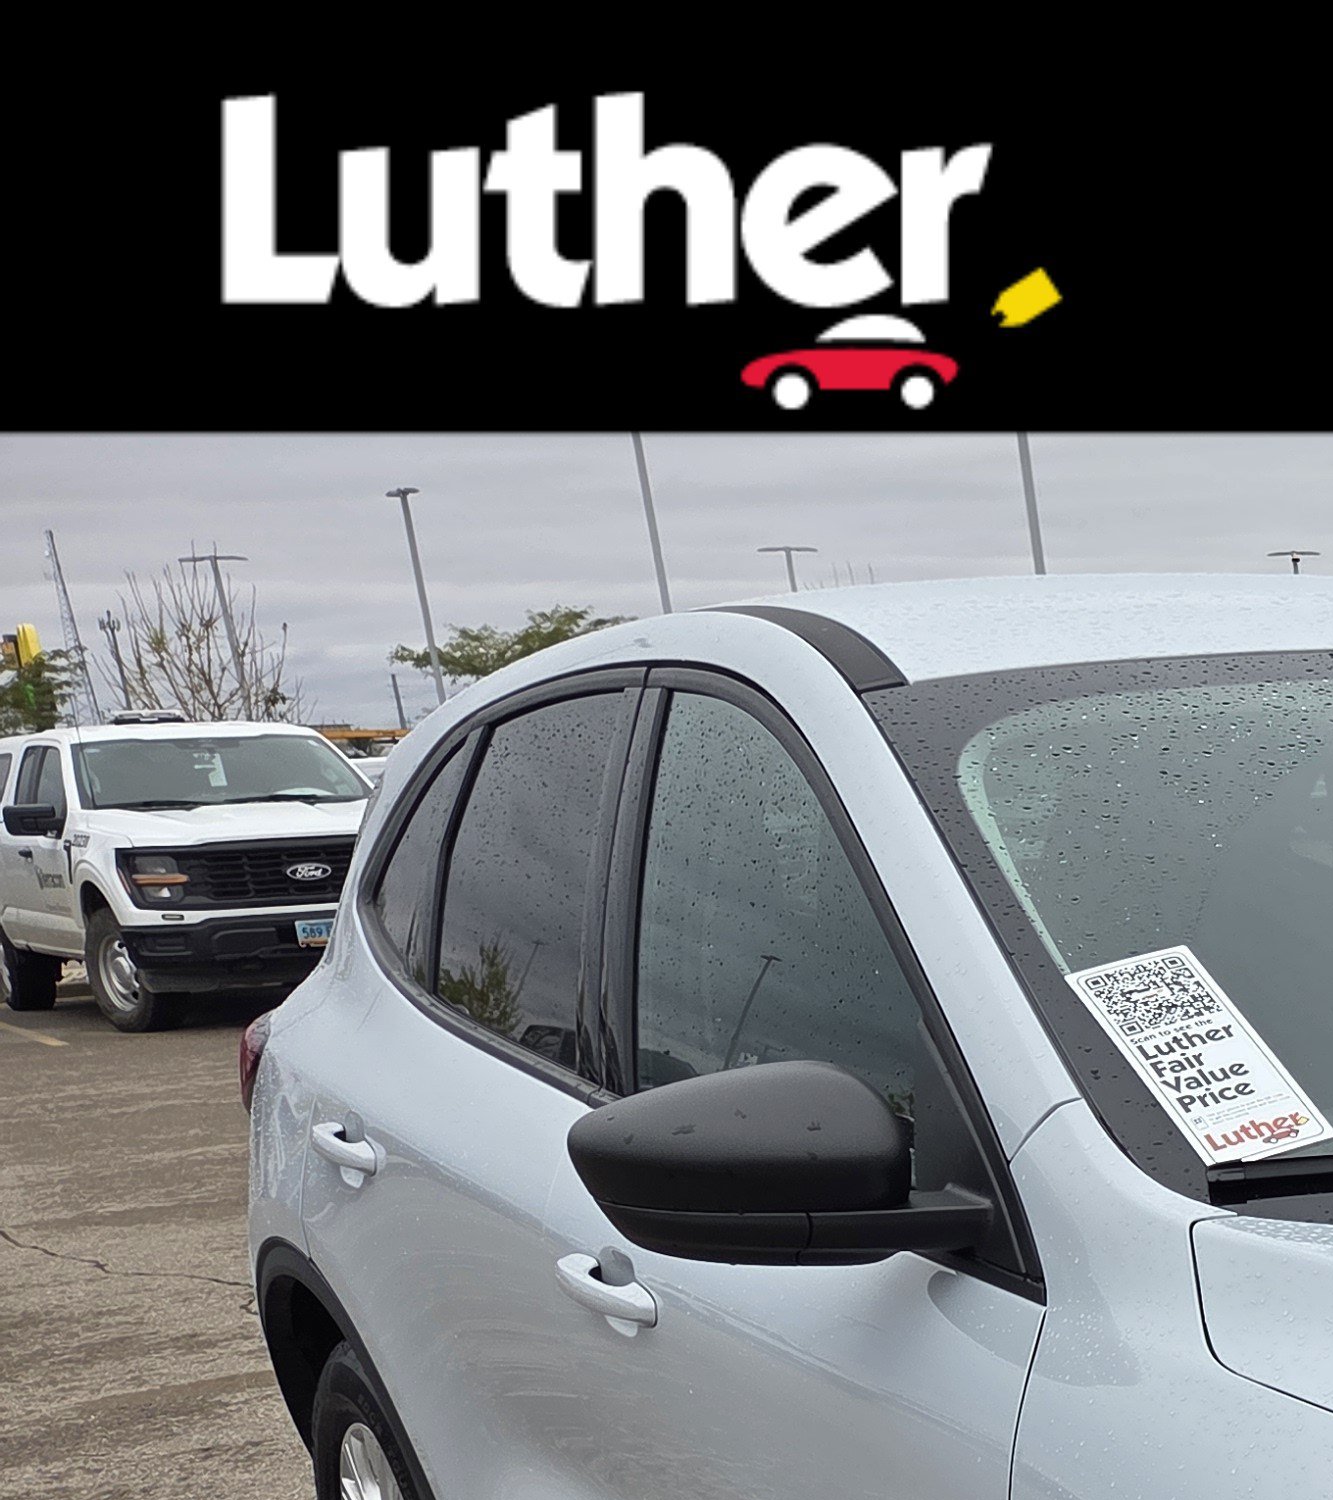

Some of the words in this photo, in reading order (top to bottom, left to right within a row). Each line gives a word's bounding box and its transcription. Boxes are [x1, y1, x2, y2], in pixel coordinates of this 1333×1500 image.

[296, 866, 323, 879] Ford
[1130, 1033, 1157, 1045] Scan
[1158, 1029, 1171, 1037] to
[1173, 1024, 1192, 1033] see
[1194, 1019, 1213, 1027] the
[1136, 1024, 1234, 1061] Luther
[1149, 1052, 1204, 1078] Fair
[1160, 1061, 1250, 1094] Value
[1176, 1080, 1256, 1114] Price
[1203, 1111, 1303, 1152] Luther
